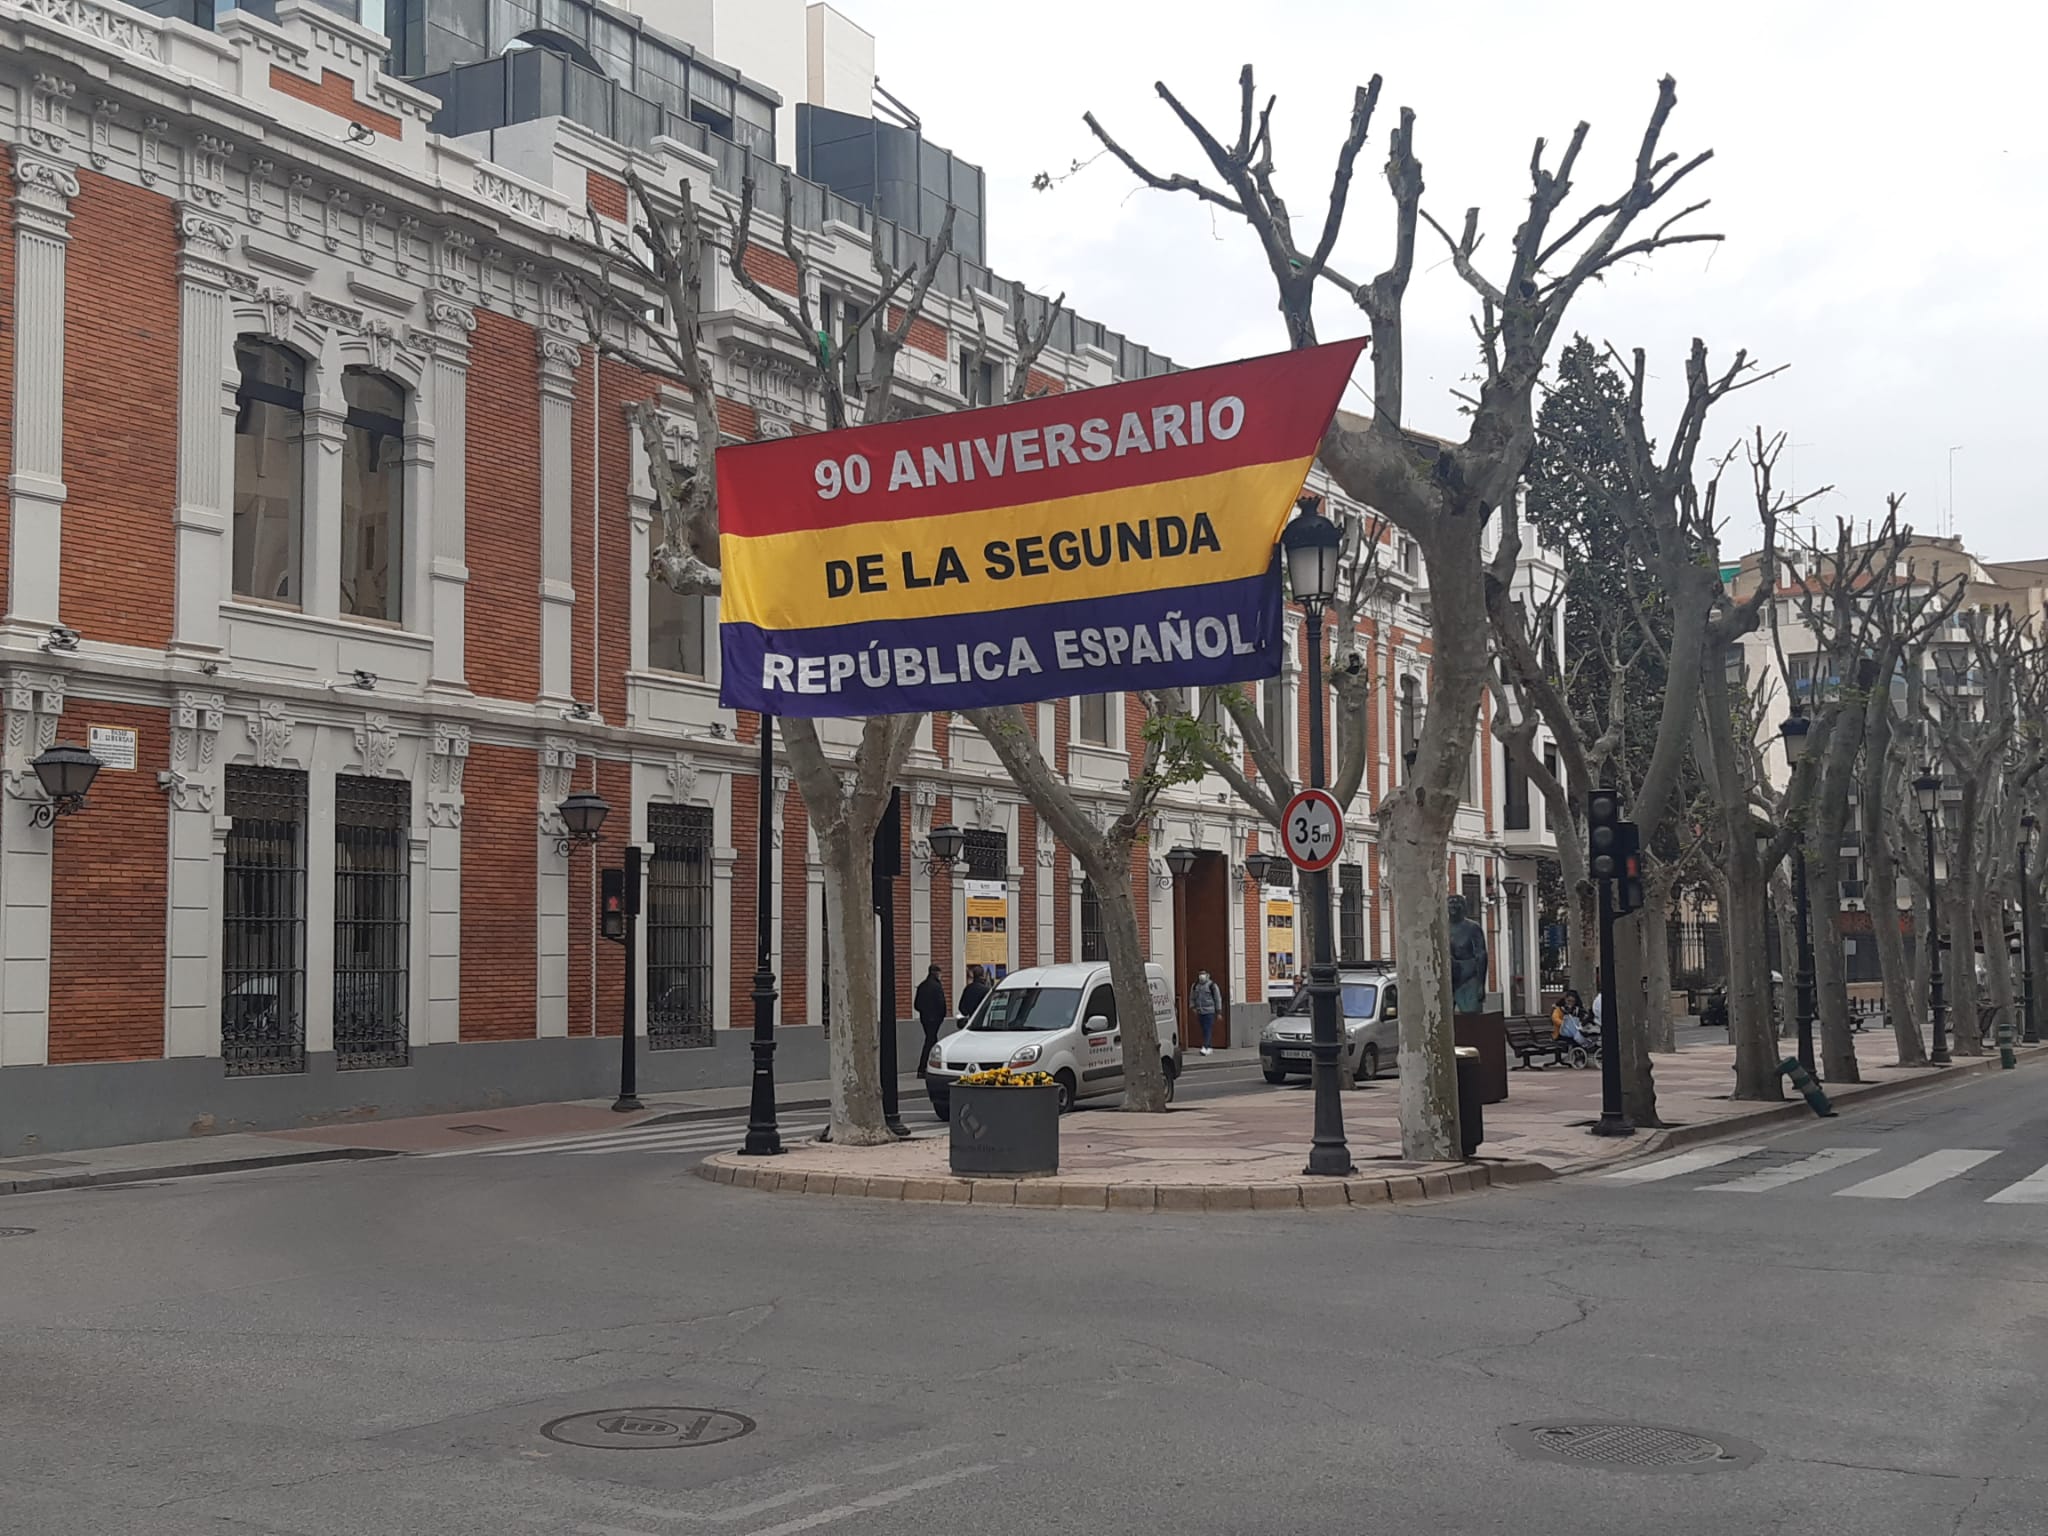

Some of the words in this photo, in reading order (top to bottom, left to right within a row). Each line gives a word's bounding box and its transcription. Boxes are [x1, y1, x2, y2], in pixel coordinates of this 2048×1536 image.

[814, 453, 871, 500] 90
[887, 395, 1246, 492] ANIVERSARIO
[824, 553, 889, 599] DE
[901, 546, 970, 590] LA
[982, 511, 1222, 581] SEGUNDA
[761, 639, 1043, 694] REPÚBLICA
[1053, 609, 1267, 671] ESPAÑOL
